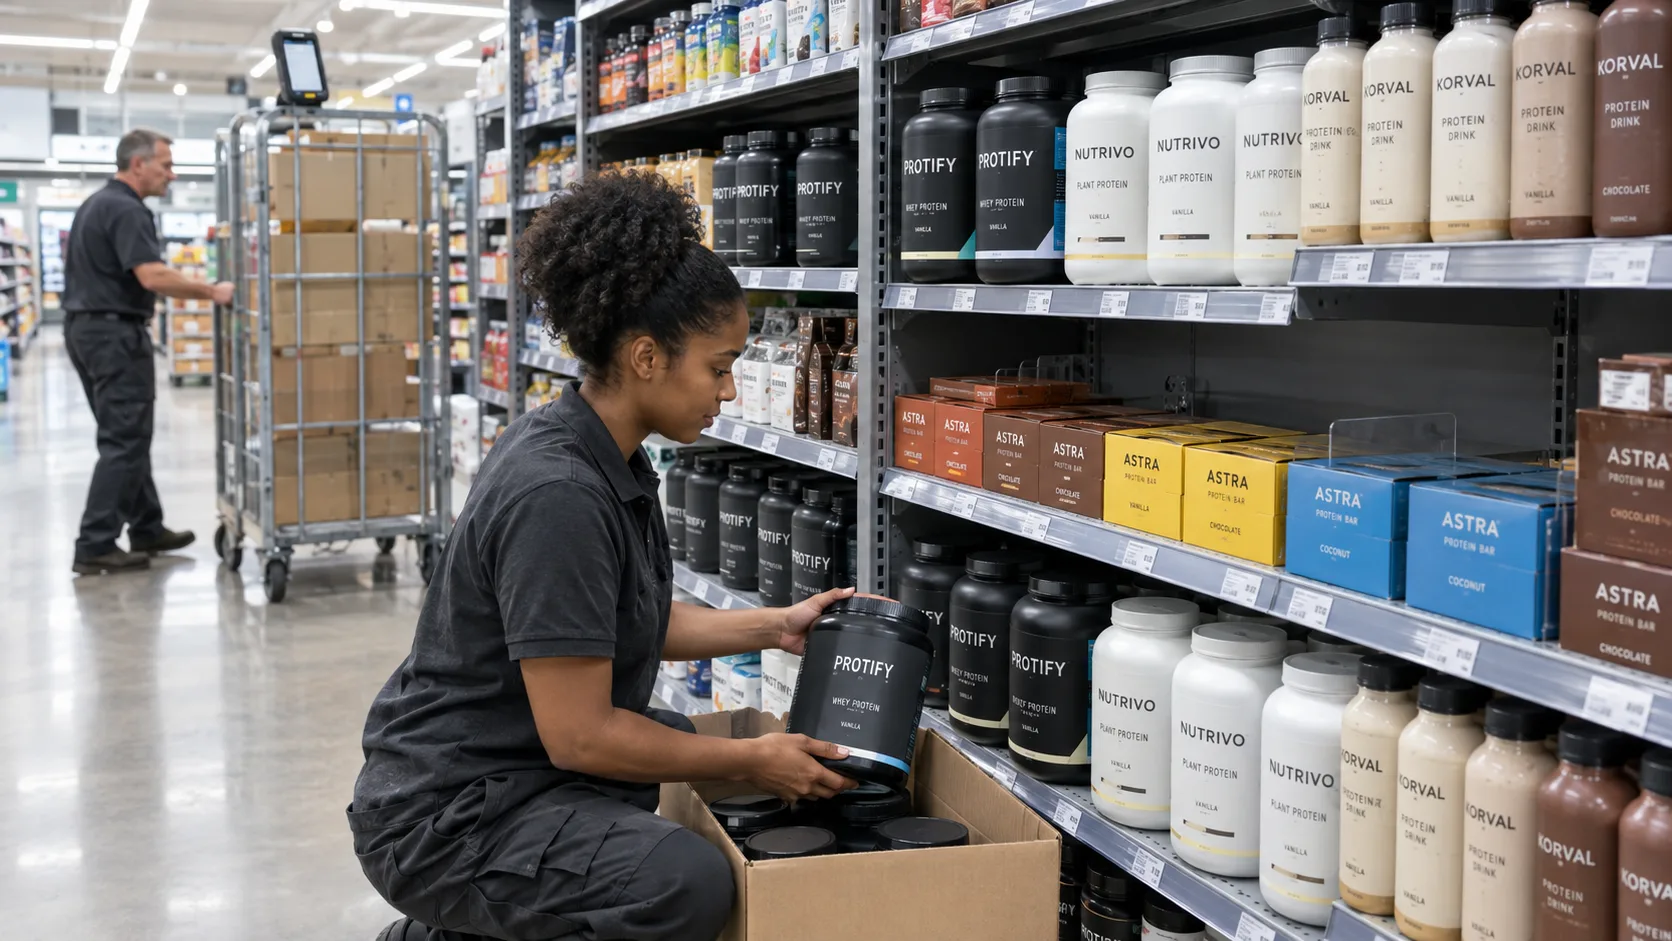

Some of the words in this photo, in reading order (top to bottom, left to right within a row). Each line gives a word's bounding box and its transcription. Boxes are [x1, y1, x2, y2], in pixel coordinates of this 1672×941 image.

[1516, 62, 1576, 81] KORVAL
[1598, 54, 1663, 76] KORVAL
[1364, 81, 1414, 98] KORVAL
[1437, 74, 1495, 91] KORVAL
[1304, 91, 1349, 105] KORVAL
[1605, 100, 1650, 113] PROTEIN
[1521, 106, 1564, 118] PROTEIN
[1368, 120, 1403, 132] PROTEIN
[1442, 115, 1485, 127] PROTEIN
[1526, 122, 1556, 133] DRINK
[1611, 116, 1640, 128] DRINK
[1157, 137, 1220, 152] NUTRIVO
[1371, 136, 1394, 145] DRINK
[1448, 131, 1475, 141] DRINK
[978, 150, 1034, 169] PROTIFY
[1075, 146, 1134, 160] NUTRIVO
[904, 158, 956, 175] PROTIFY
[1246, 170, 1266, 179] PLANT
[1268, 169, 1302, 178] PROTEIN
[1077, 181, 1094, 190] PLANT
[1097, 180, 1128, 188] PROTEIN
[1159, 174, 1178, 183] PLANT
[1180, 173, 1212, 182] PROTEIN
[713, 186, 736, 200] PROTIF
[737, 184, 779, 198] PROTIFY
[798, 182, 842, 195] PROTIFY
[1602, 184, 1650, 196] CHOCOLATE
[920, 202, 947, 211] PROTEIN
[995, 198, 1024, 207] PROTEIN
[1446, 194, 1474, 202] VANILLA
[902, 412, 925, 425] ASTRA
[944, 419, 970, 434] ASTRA
[996, 431, 1024, 447] ASTRA
[1053, 442, 1084, 460] ASTRA
[1607, 447, 1670, 471] ASTRA
[1124, 453, 1160, 471] ASTRA
[1147, 476, 1156, 485] BAR
[1207, 469, 1248, 490] ASTRA
[1608, 472, 1643, 487] PROTEIN
[1647, 477, 1665, 489] BAR
[1208, 491, 1230, 502] PROTEIN
[1234, 494, 1245, 505] BAR
[1315, 486, 1361, 509] ASTRA
[1316, 509, 1342, 521] PROTEIN
[1345, 515, 1358, 526] BAR
[1442, 512, 1499, 538] ASTRA
[1610, 508, 1660, 525] CHOCOLATE
[1210, 521, 1241, 535] CHOCOLATE
[1320, 544, 1351, 559] COCONUT
[1444, 536, 1476, 552] PROTEIN
[1479, 543, 1495, 556] BAR
[1448, 575, 1486, 592] COCONUT
[1595, 582, 1660, 614] ASTRA
[1597, 609, 1634, 627] PROTEIN
[1637, 619, 1656, 632] BAR
[950, 625, 997, 648] PROTIFY
[1600, 642, 1652, 666] CHOCOLATE
[834, 655, 894, 678] PROTIFY
[1012, 650, 1066, 677] PROTIFY
[832, 697, 850, 706] WHEY
[1098, 688, 1156, 712] NUTRIVO
[840, 721, 860, 730] VANILLA
[1100, 723, 1116, 736] PLANT
[1118, 729, 1148, 741] PROTEIN
[1181, 721, 1245, 747] NUTRIVO
[1111, 760, 1131, 770] VANILLA
[1183, 758, 1202, 772] PLANT
[1204, 765, 1237, 779] PROTEIN
[1270, 759, 1334, 788] NUTRIVO
[1399, 774, 1445, 800] KORVAL
[1195, 800, 1218, 812] VANILLA
[1271, 799, 1290, 815] PLANT
[1292, 807, 1327, 822] PROTEIN
[1401, 814, 1435, 834] PROTEIN
[1466, 802, 1516, 830] KORVAL
[1469, 844, 1506, 866] PROTEIN
[1538, 832, 1596, 866] KORVAL
[1473, 861, 1496, 878] DRINK
[1543, 878, 1583, 903] PROTEIN
[1621, 867, 1672, 900] KORVA
[1626, 916, 1672, 940] PROTEIN
